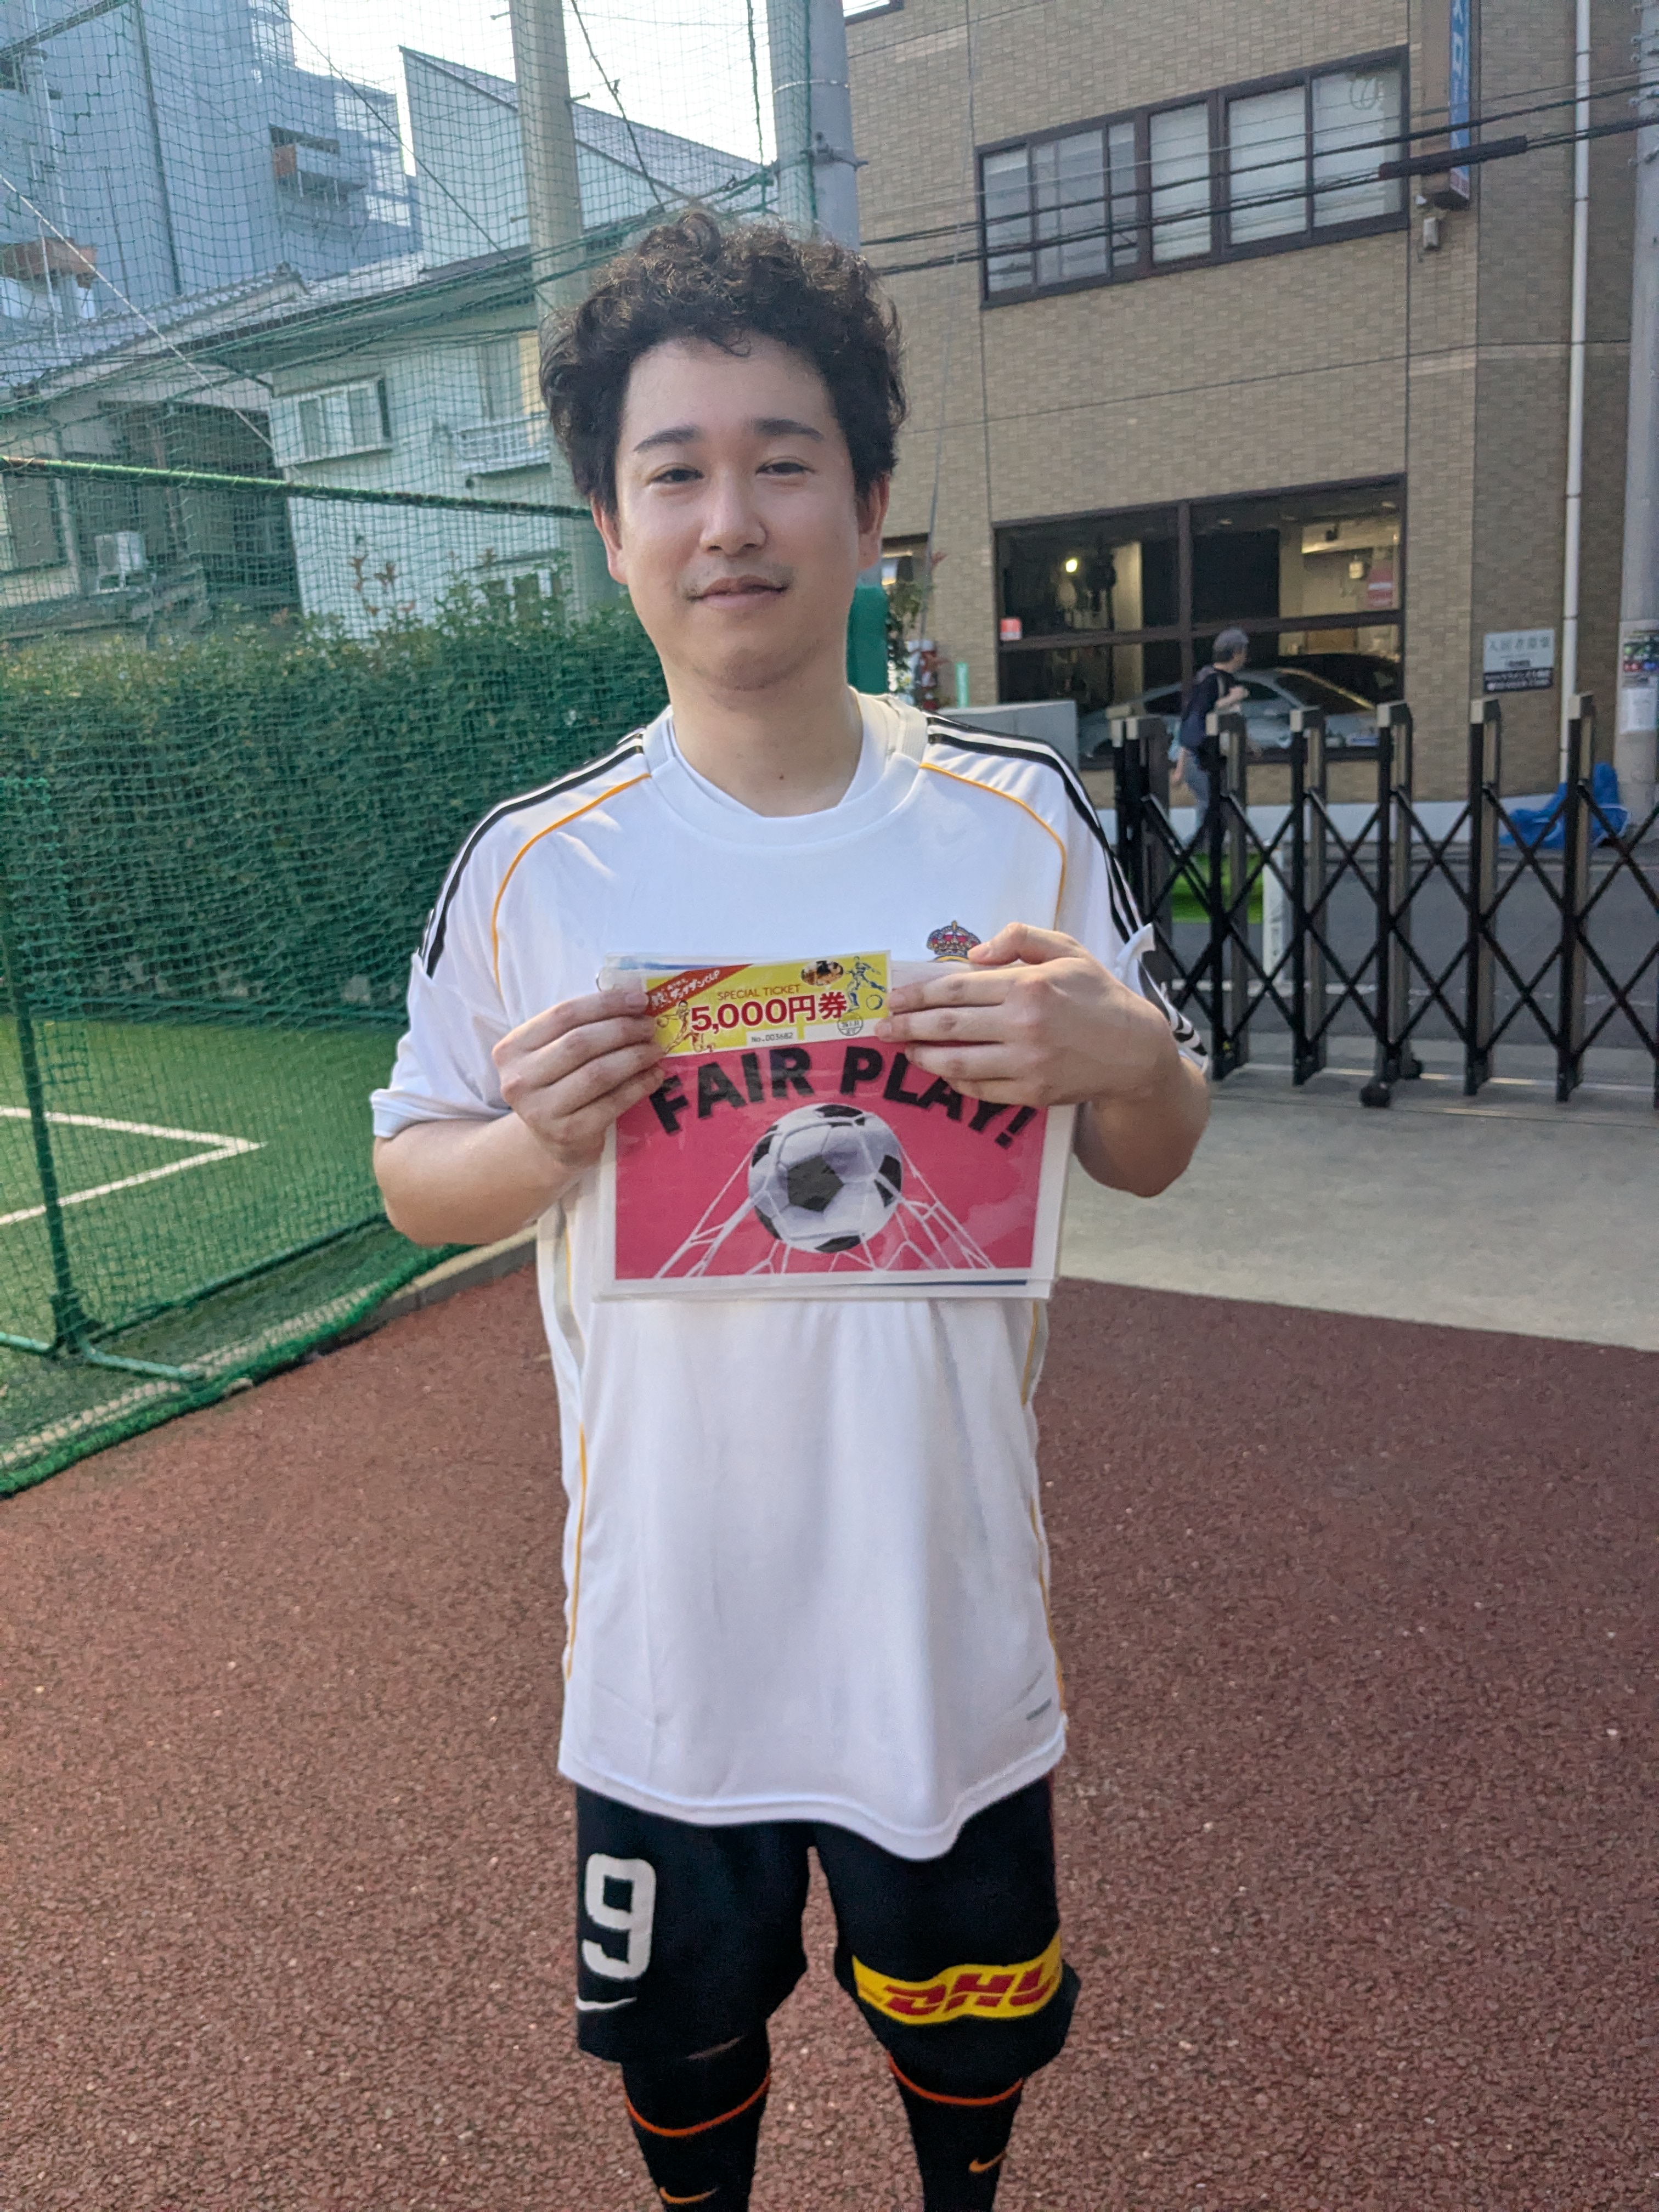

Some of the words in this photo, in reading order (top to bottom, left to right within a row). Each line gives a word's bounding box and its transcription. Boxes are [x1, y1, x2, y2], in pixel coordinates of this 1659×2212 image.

[691, 991, 848, 1035] 5,000円券
[717, 988, 761, 1001] SPECIAL
[763, 984, 801, 996] TICKET
[648, 1047, 815, 1135] FAIR
[839, 1046, 1037, 1150] PLAY!
[582, 1852, 656, 1982] 9
[884, 1962, 1057, 2016] DHL
